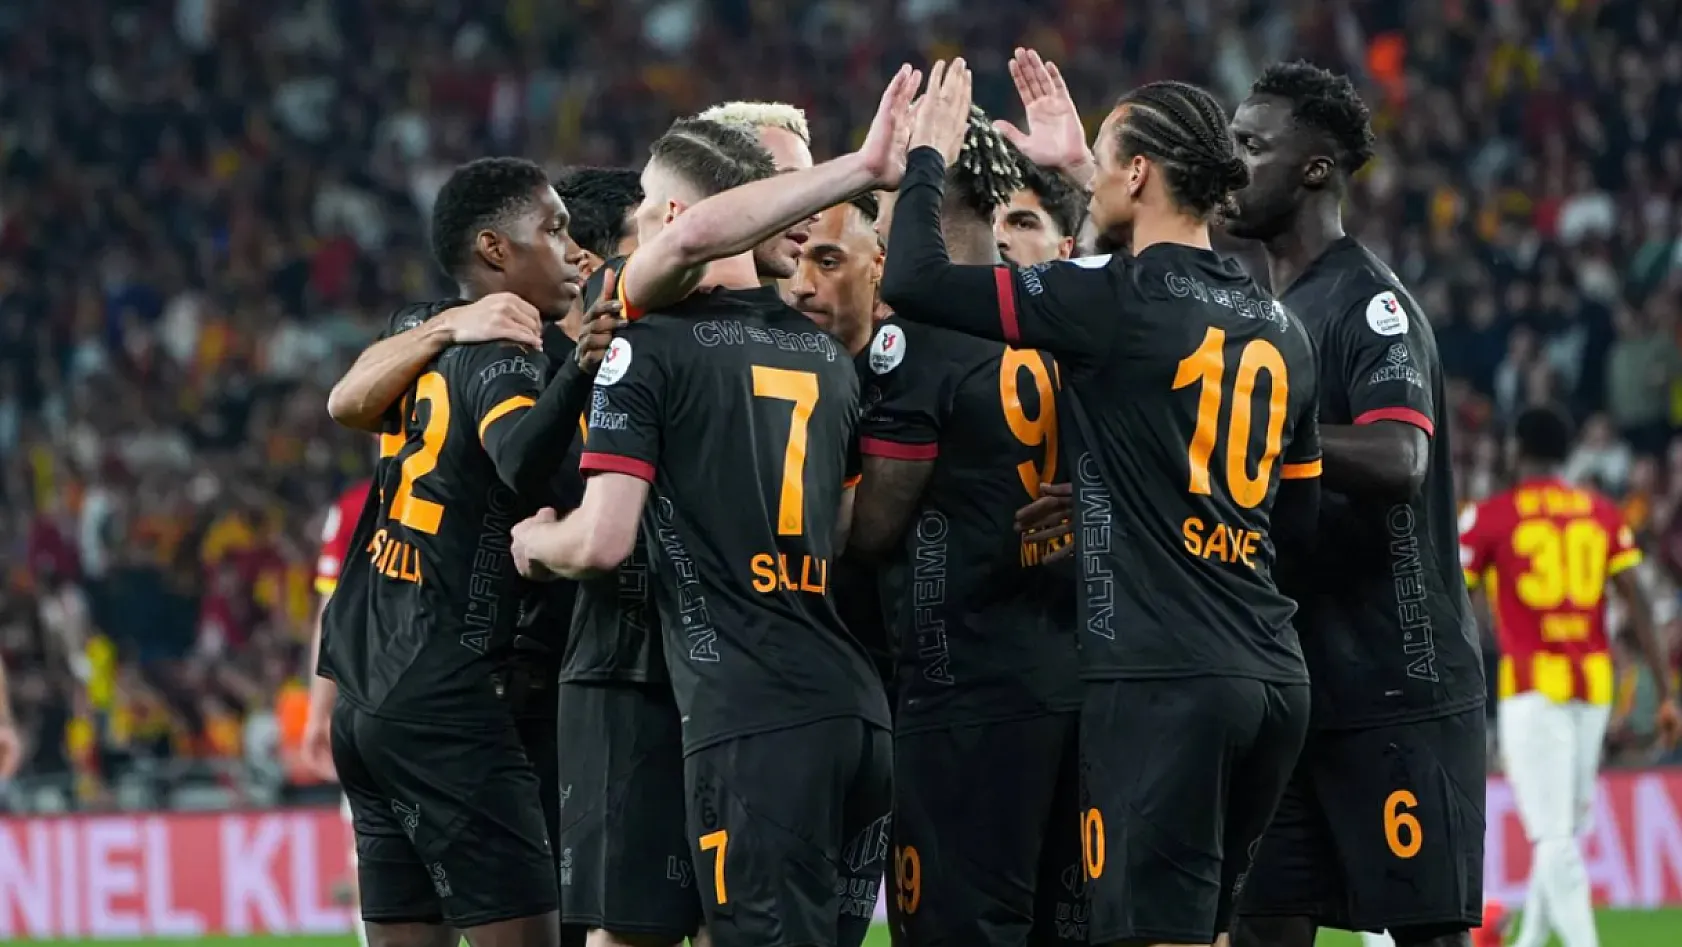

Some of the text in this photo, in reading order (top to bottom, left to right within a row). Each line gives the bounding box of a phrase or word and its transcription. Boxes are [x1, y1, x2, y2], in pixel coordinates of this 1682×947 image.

[693, 319, 745, 348] CW
[751, 365, 819, 536] 7
[1171, 325, 1289, 509] 10
[1512, 518, 1608, 611] 30
[699, 829, 729, 905] 7
[1382, 788, 1424, 860] 6
[0, 815, 207, 940] NIEL
